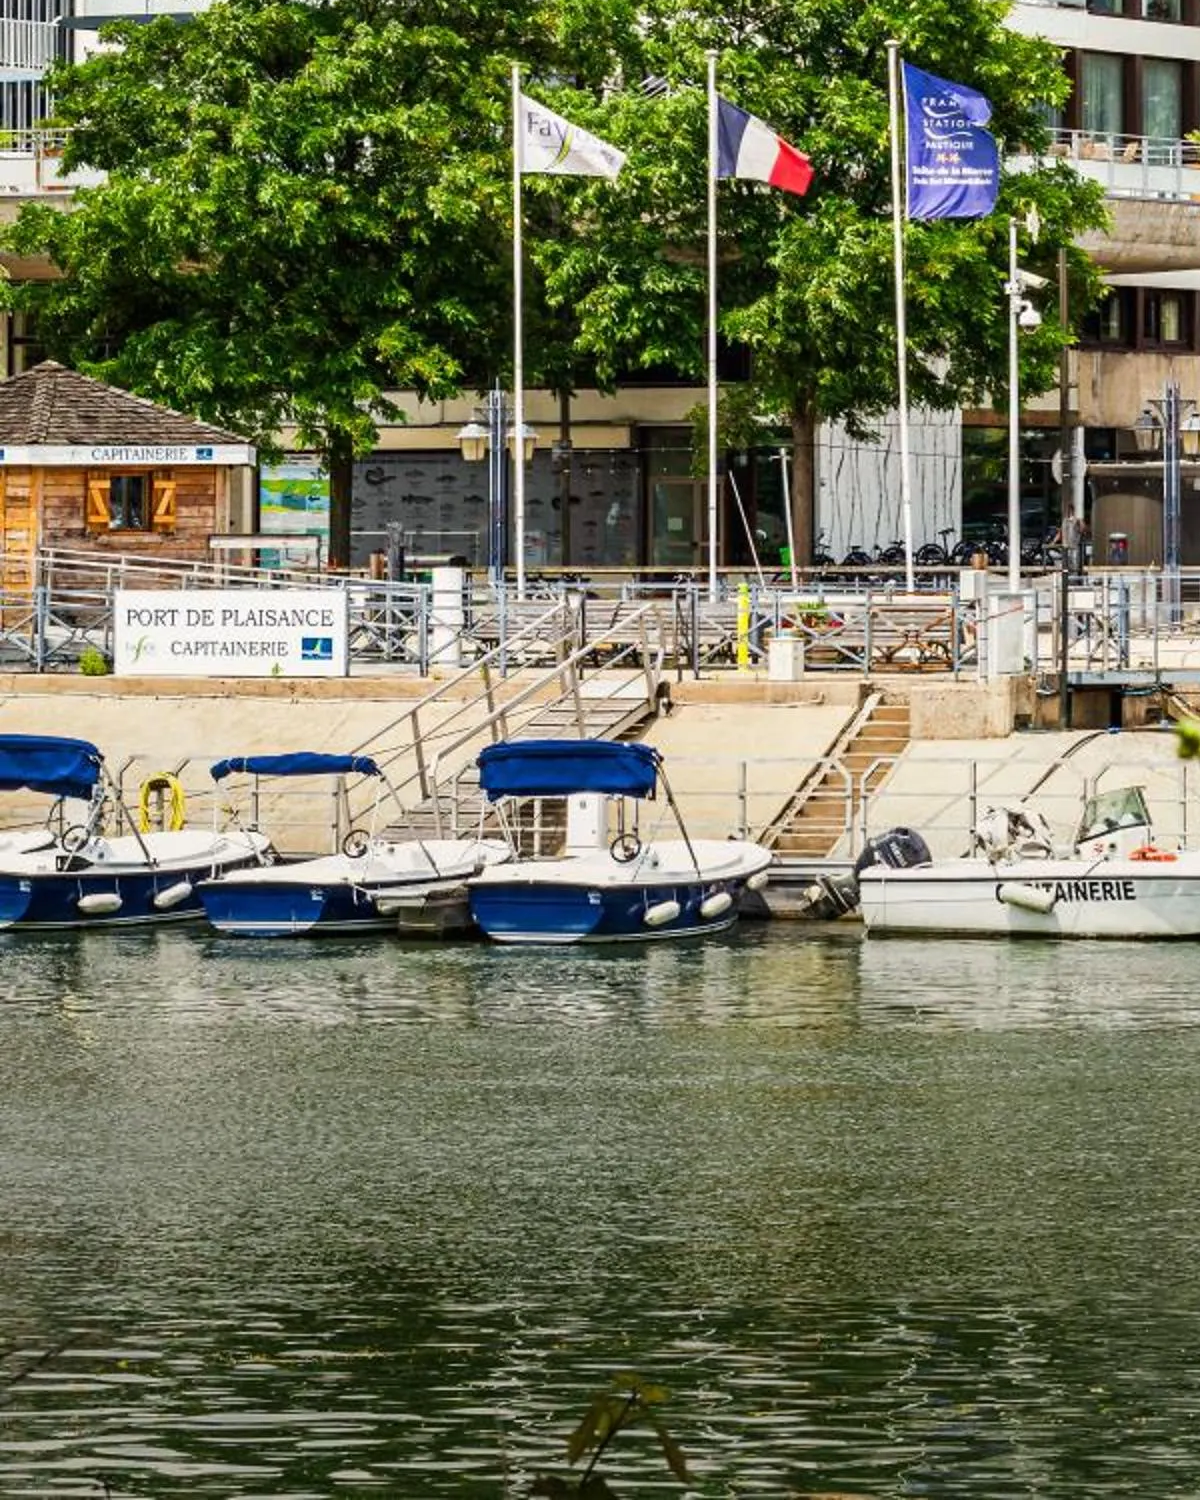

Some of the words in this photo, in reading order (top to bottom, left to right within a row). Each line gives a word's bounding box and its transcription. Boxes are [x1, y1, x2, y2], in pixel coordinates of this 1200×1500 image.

[91, 447, 188, 461] CAPITAINERIE
[126, 609, 179, 627] PORT
[186, 609, 214, 627] DE
[221, 609, 334, 627] PLAISANCE
[170, 640, 289, 657] CAPITAINERIE
